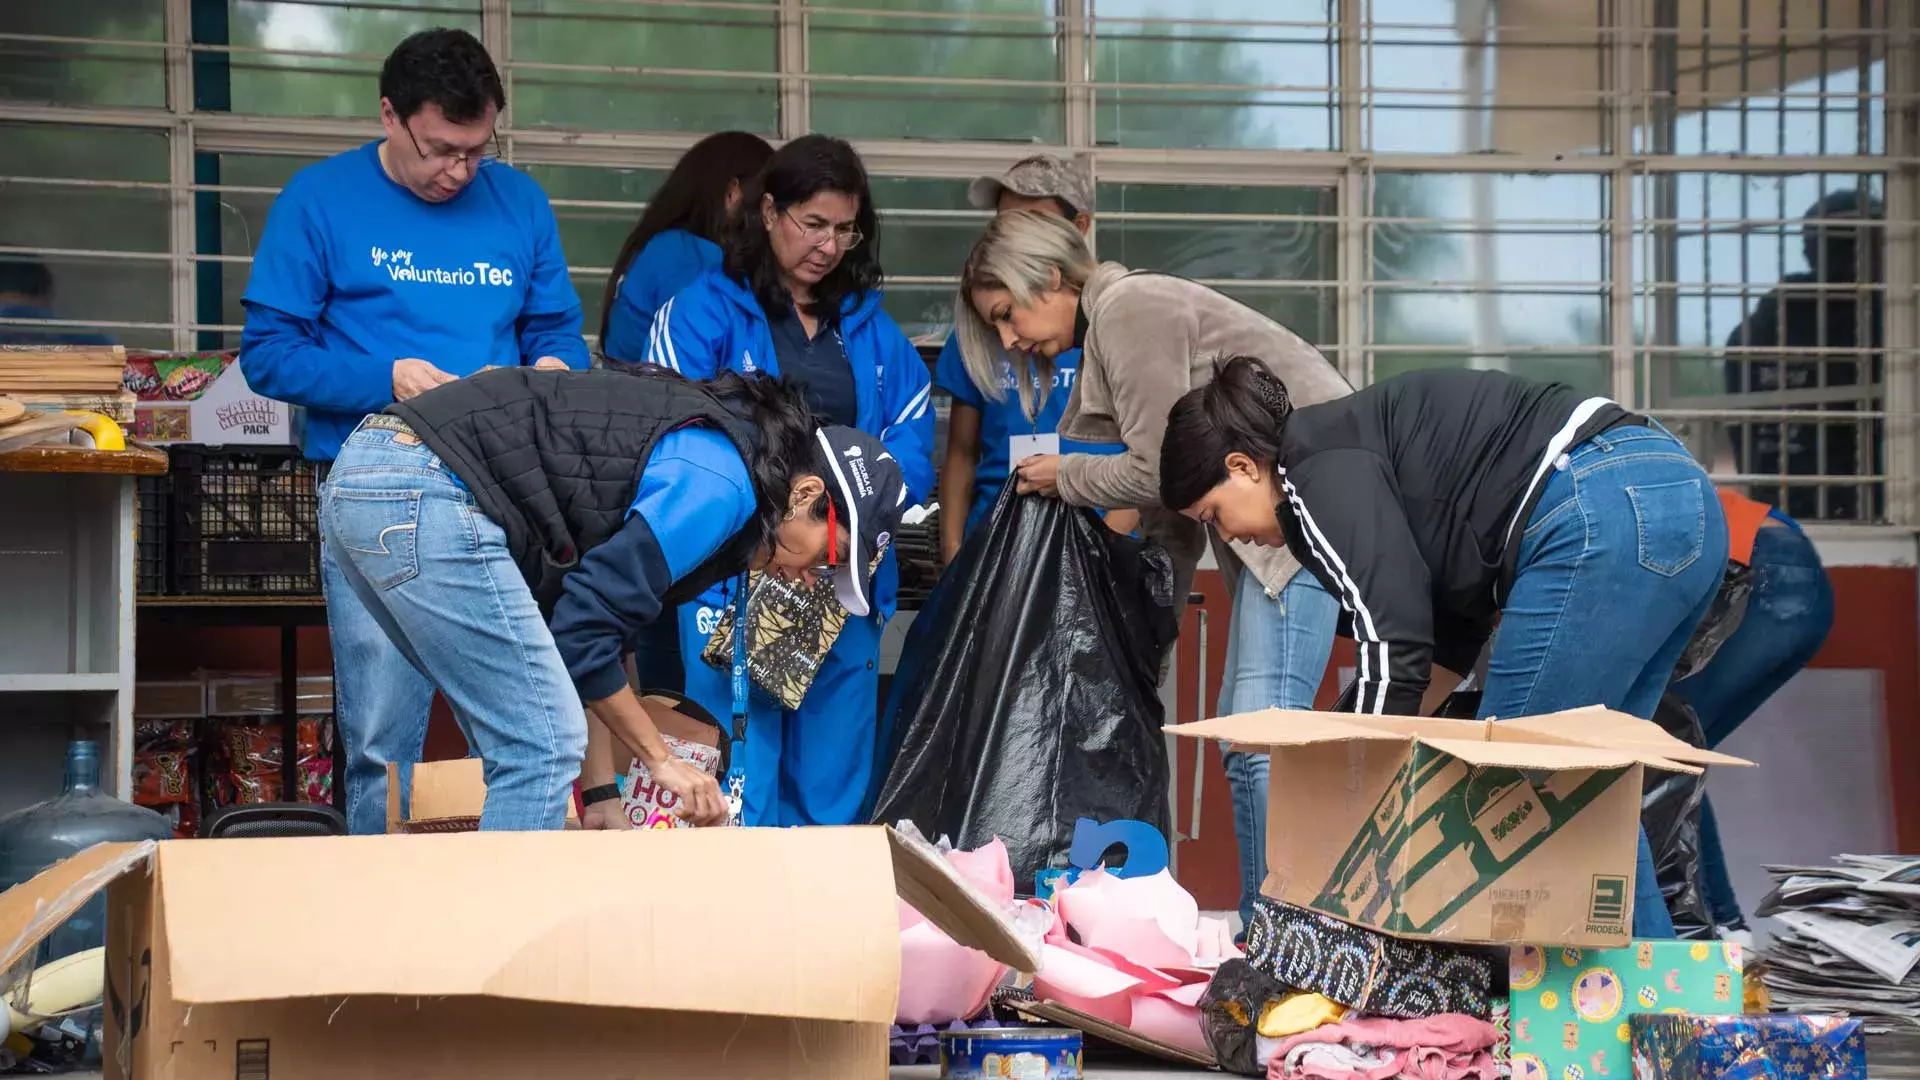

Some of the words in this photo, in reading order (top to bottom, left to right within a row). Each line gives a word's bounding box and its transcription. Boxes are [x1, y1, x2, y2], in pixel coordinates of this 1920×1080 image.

[371, 246, 388, 267] Yo
[391, 248, 413, 265] soy
[218, 411, 280, 431] NEGOCIO
[243, 424, 270, 435] PACK
[855, 457, 871, 486] ESCUELA
[632, 775, 678, 809] HO
